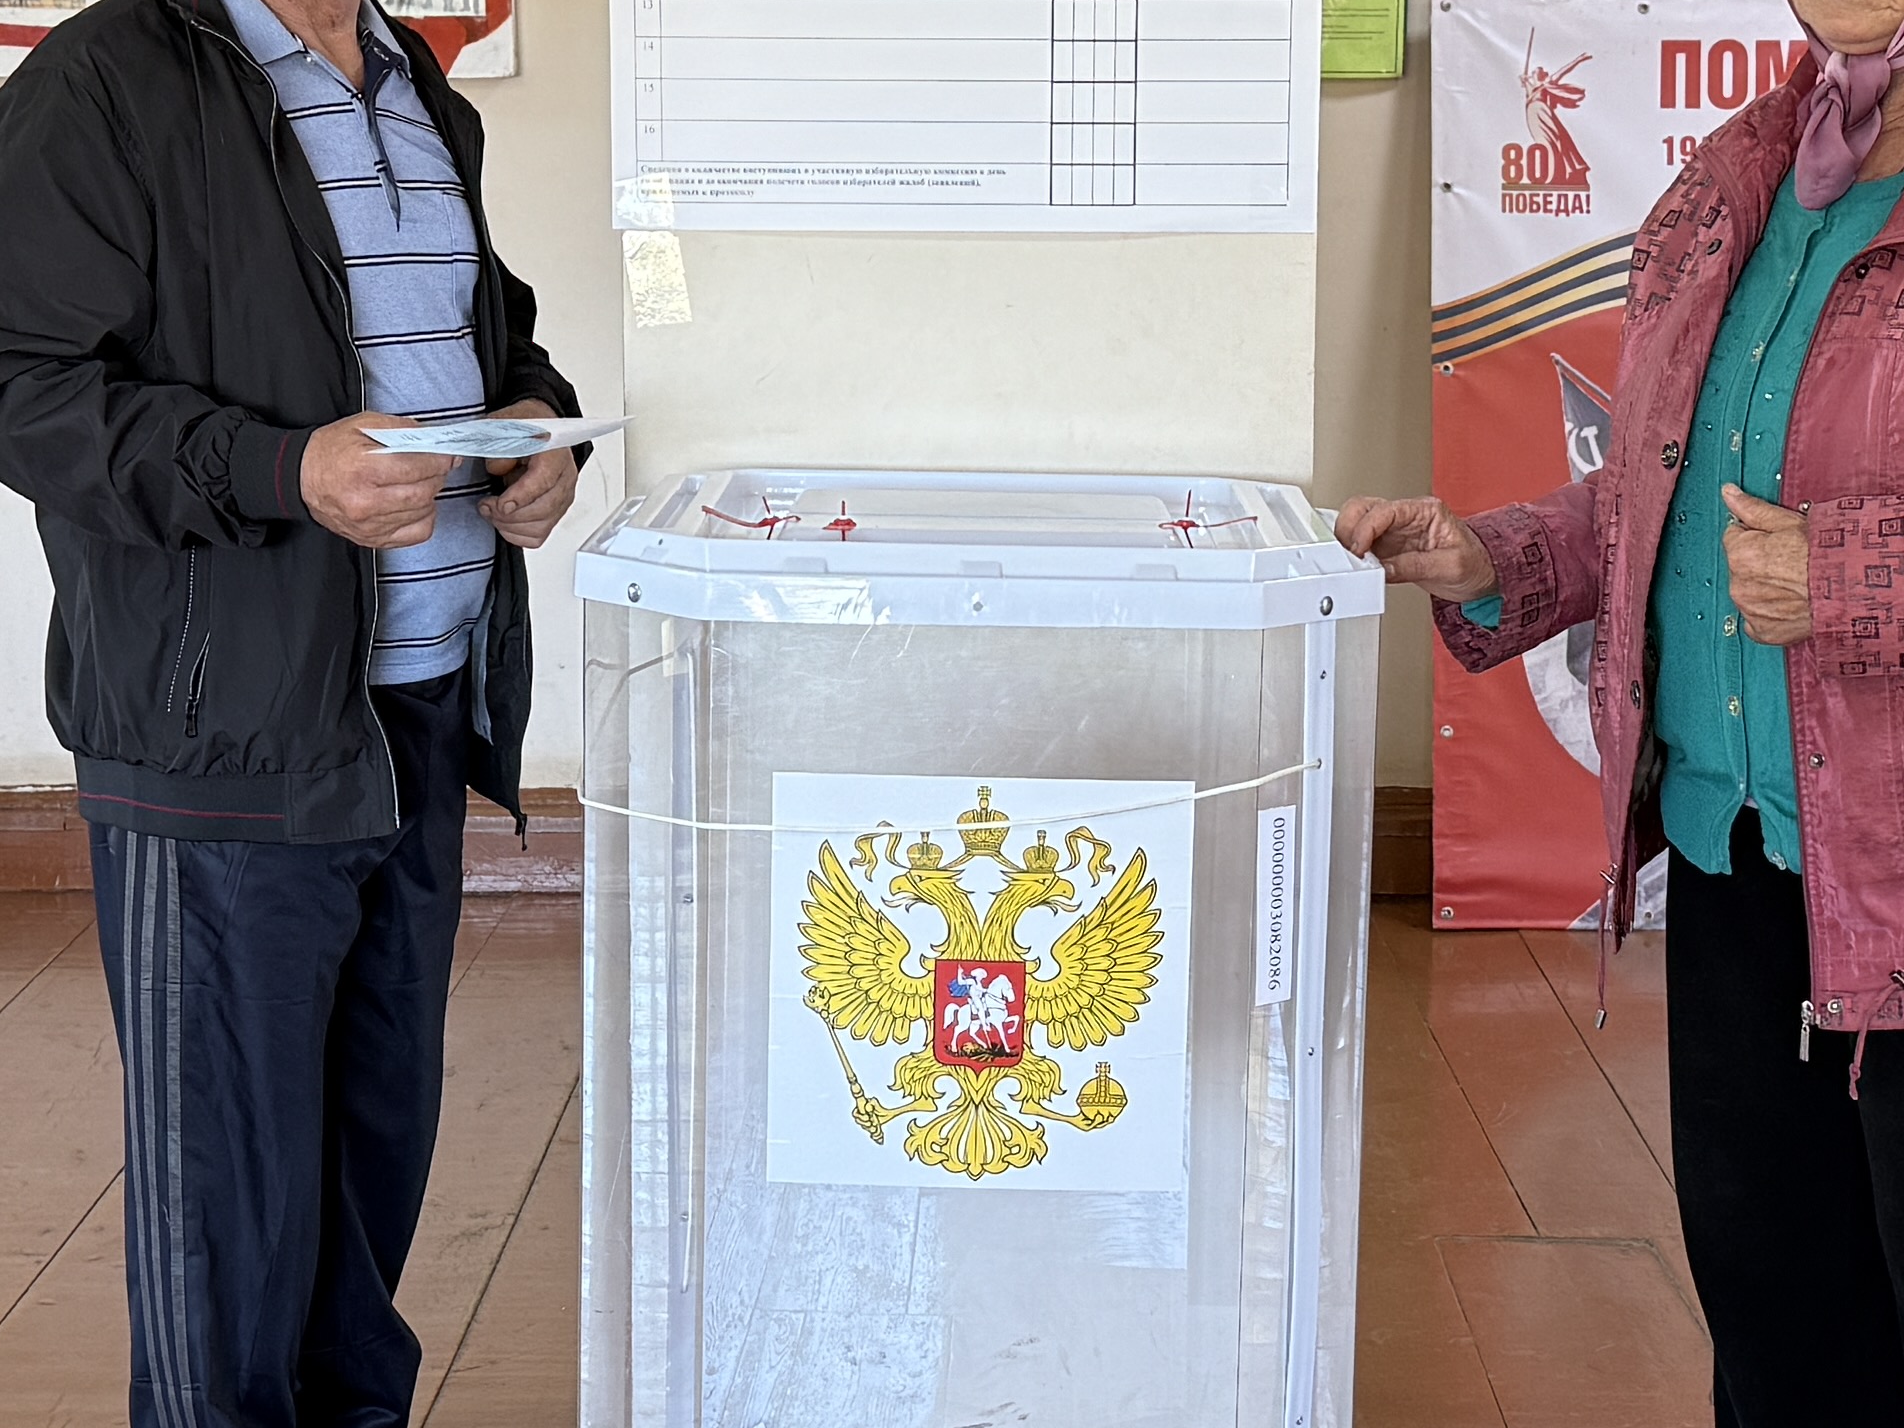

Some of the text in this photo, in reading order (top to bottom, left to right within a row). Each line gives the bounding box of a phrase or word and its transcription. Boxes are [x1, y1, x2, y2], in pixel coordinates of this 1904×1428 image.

[642, 0, 654, 10] 13
[643, 41, 654, 51] 14
[643, 82, 655, 93] 15
[644, 124, 656, 134] 16
[1662, 135, 1707, 166] 19
[1501, 142, 1550, 185] 80
[1501, 192, 1592, 217] ПОБЕДА!
[1268, 817, 1286, 991] 000000003082086
